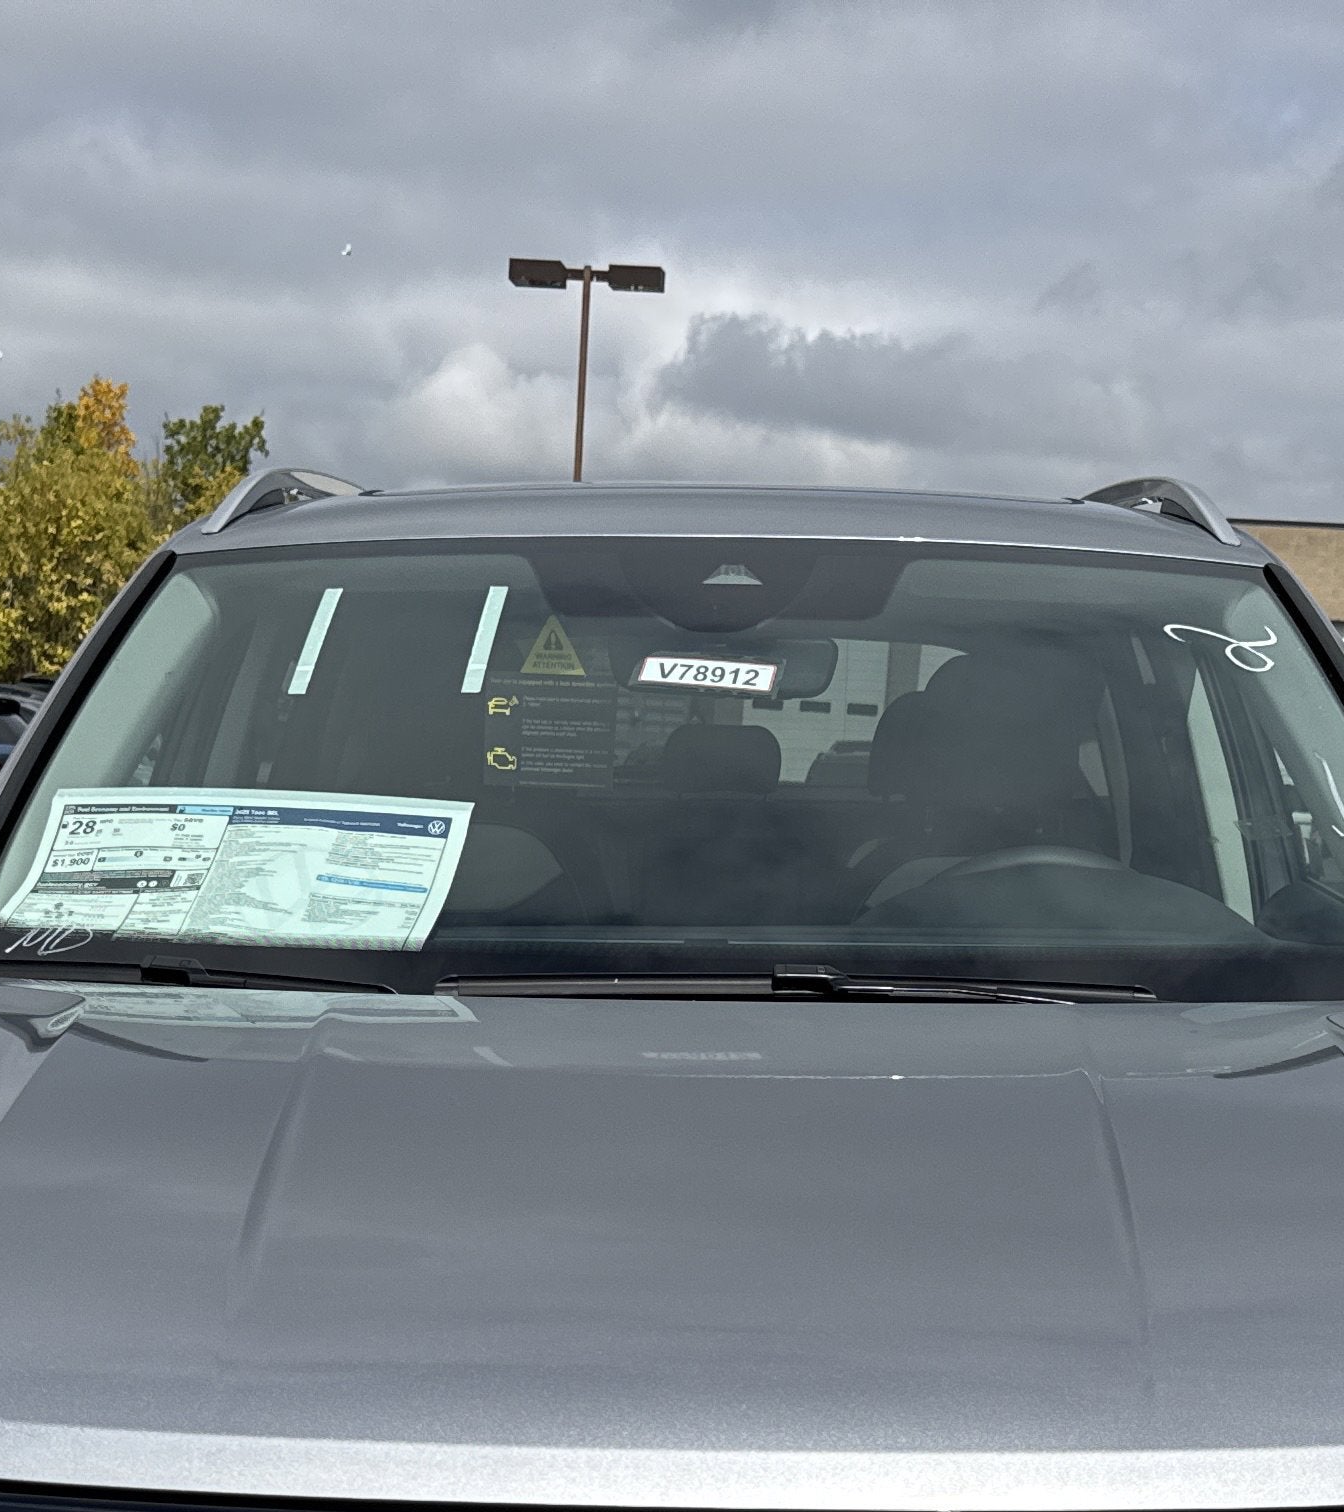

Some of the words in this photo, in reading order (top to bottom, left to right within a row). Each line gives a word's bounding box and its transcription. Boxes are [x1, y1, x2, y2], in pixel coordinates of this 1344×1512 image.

[659, 662, 760, 687] V78912
[68, 820, 97, 836] 28
[51, 857, 91, 868] $1,900
